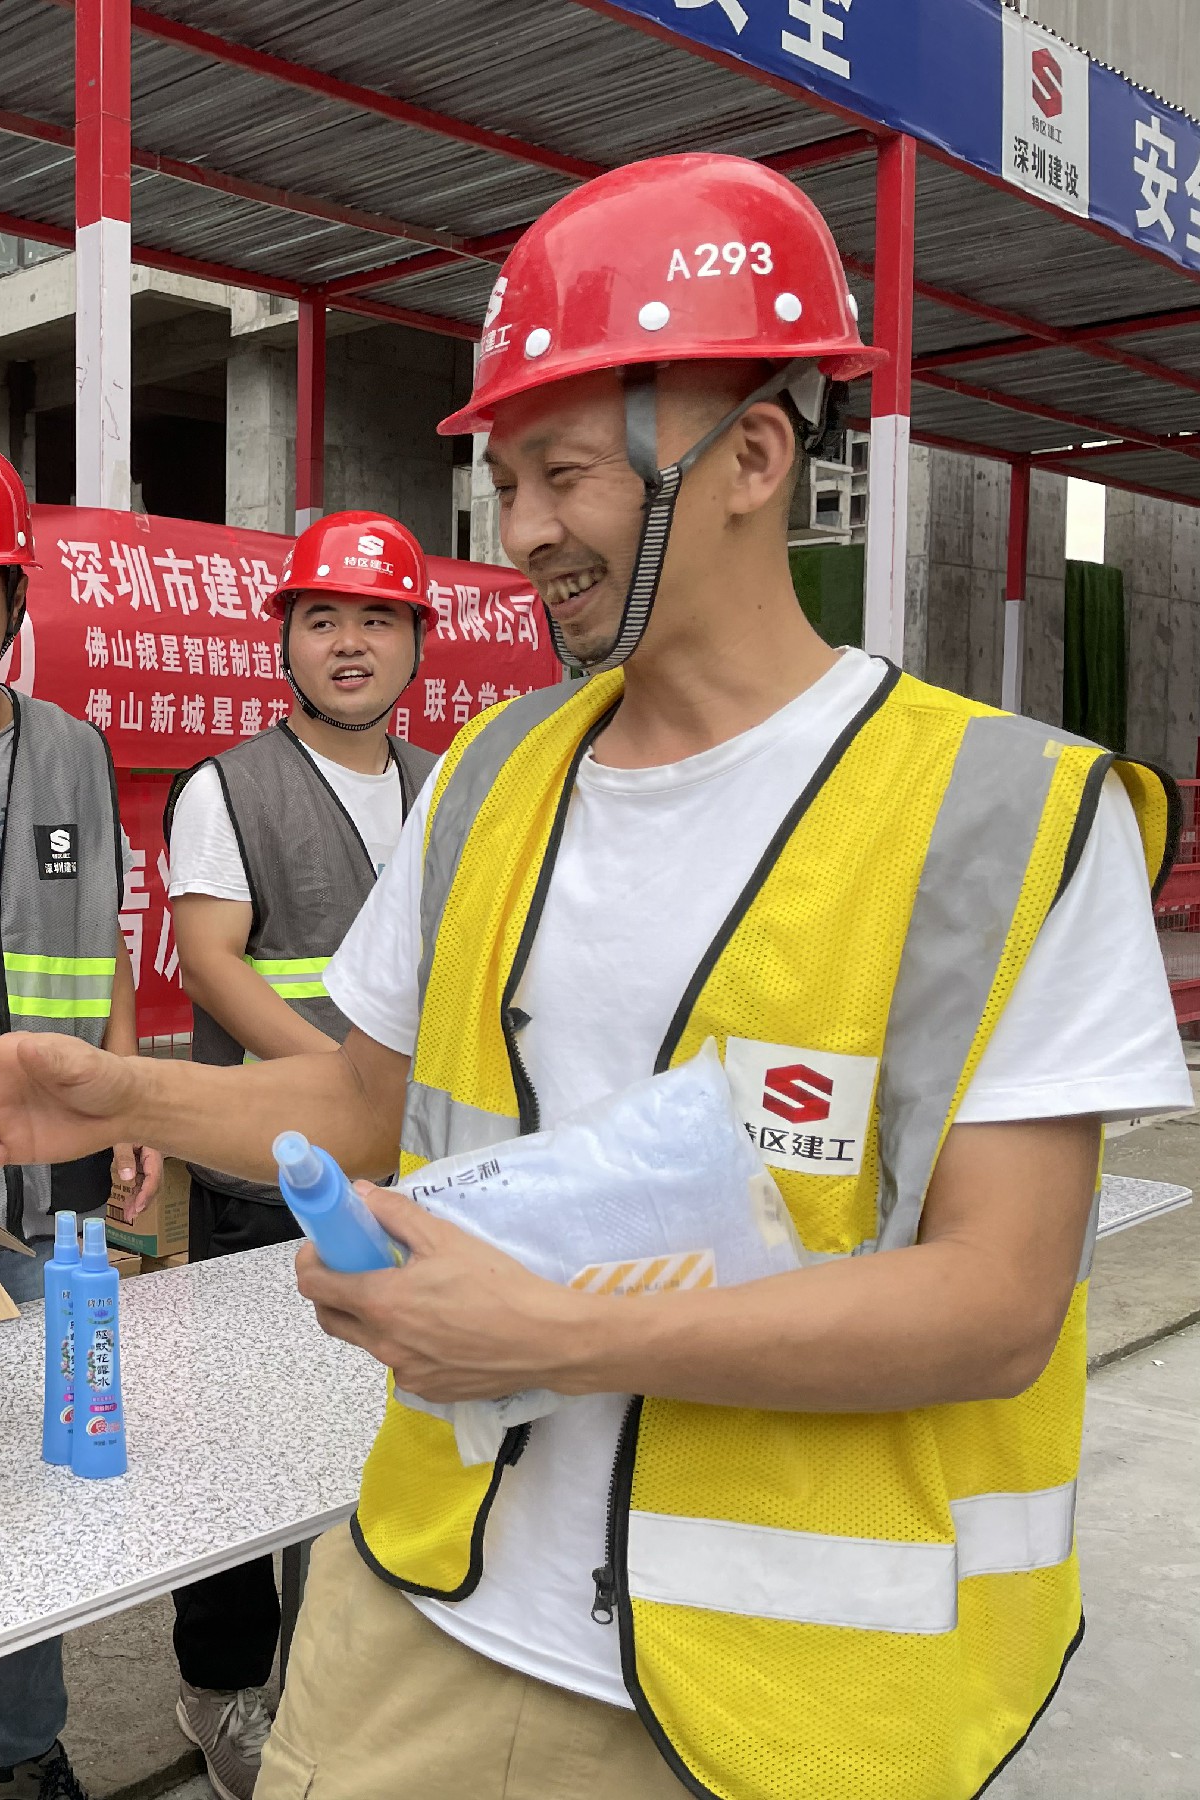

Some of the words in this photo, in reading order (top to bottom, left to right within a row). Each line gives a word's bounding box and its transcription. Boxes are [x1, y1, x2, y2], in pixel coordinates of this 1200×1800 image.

[1013, 136, 1079, 199] 深圳建设
[666, 241, 775, 283] A293
[427, 579, 539, 652] 有限公司
[94, 1329, 111, 1388] 驱蚊花露水
